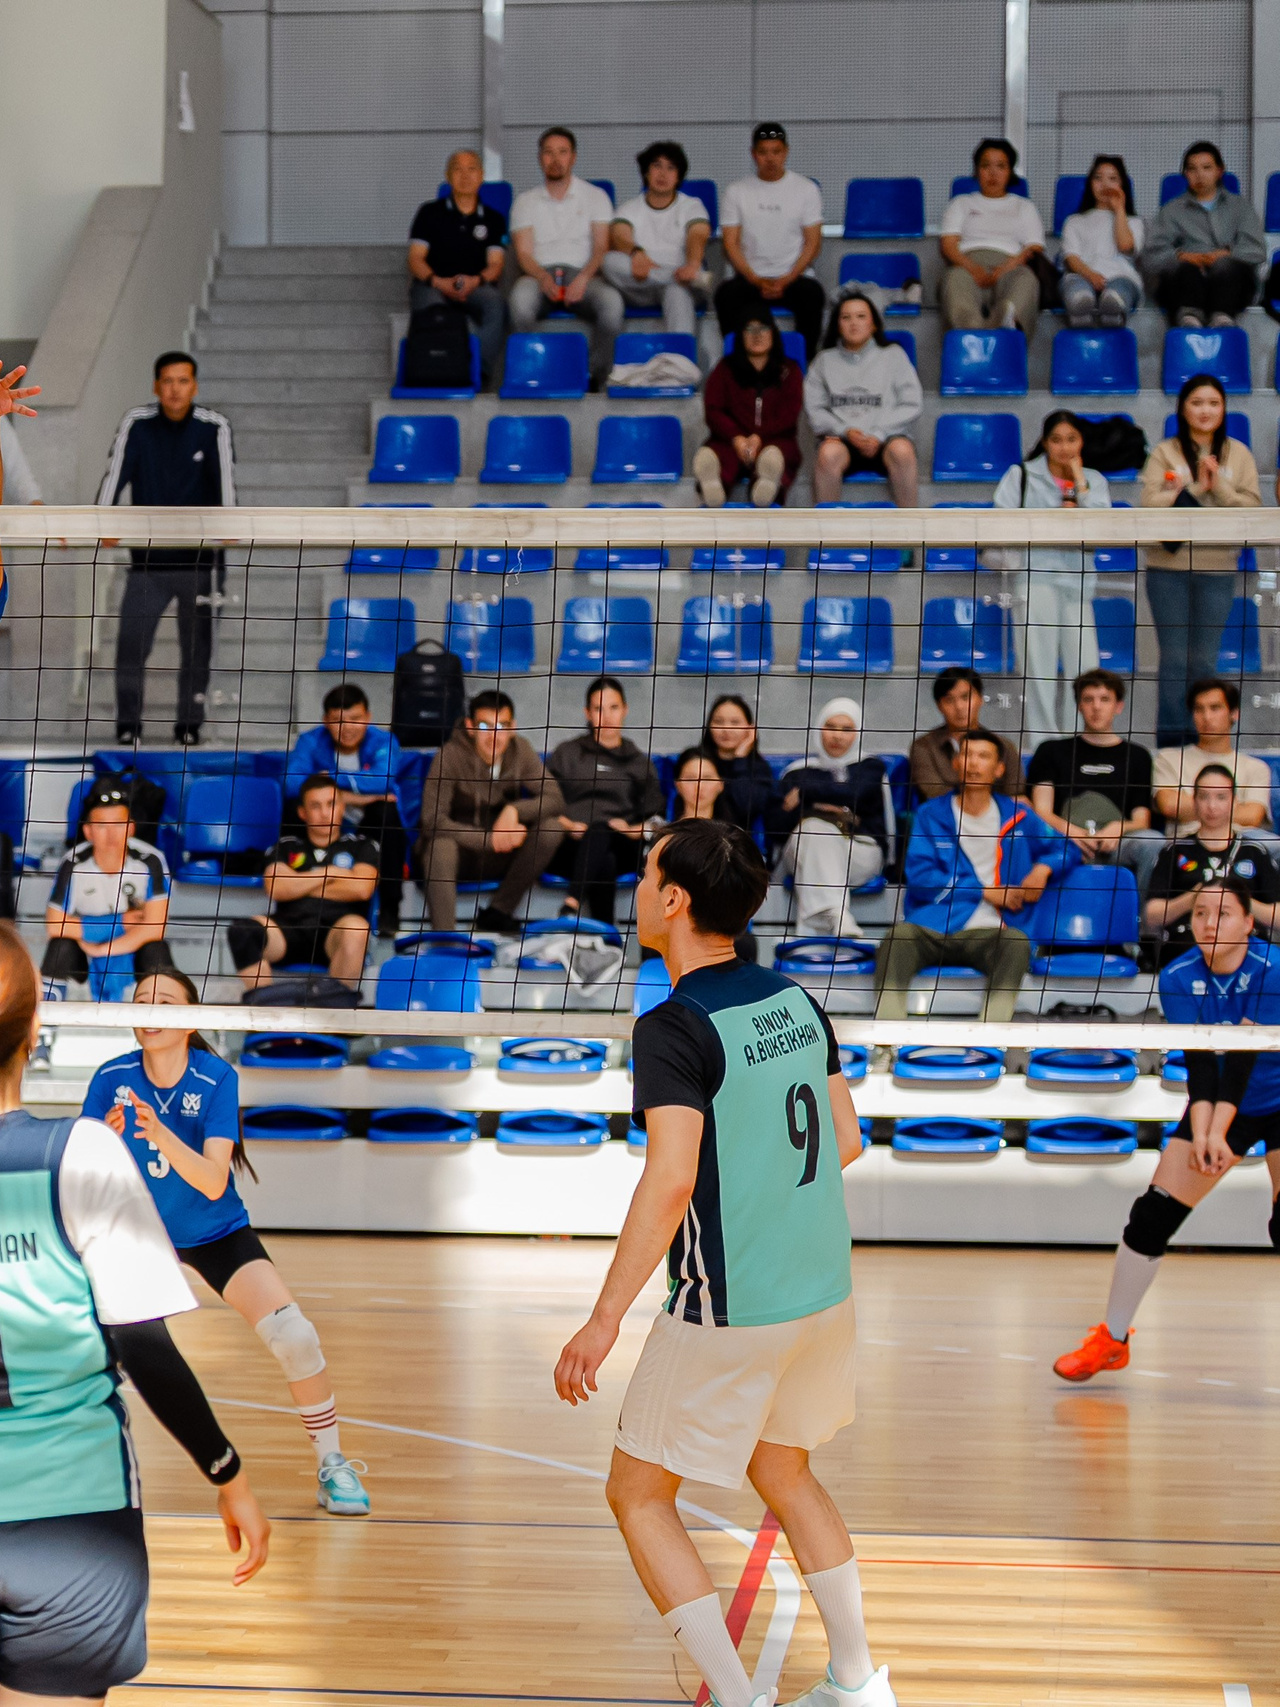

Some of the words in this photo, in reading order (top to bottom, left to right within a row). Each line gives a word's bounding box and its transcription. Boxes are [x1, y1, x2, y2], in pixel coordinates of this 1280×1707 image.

[752, 1006, 795, 1037] BINOM
[743, 1022, 820, 1067] A.BOKEIKHAN
[786, 1082, 820, 1188] 9
[147, 1141, 170, 1178] 3
